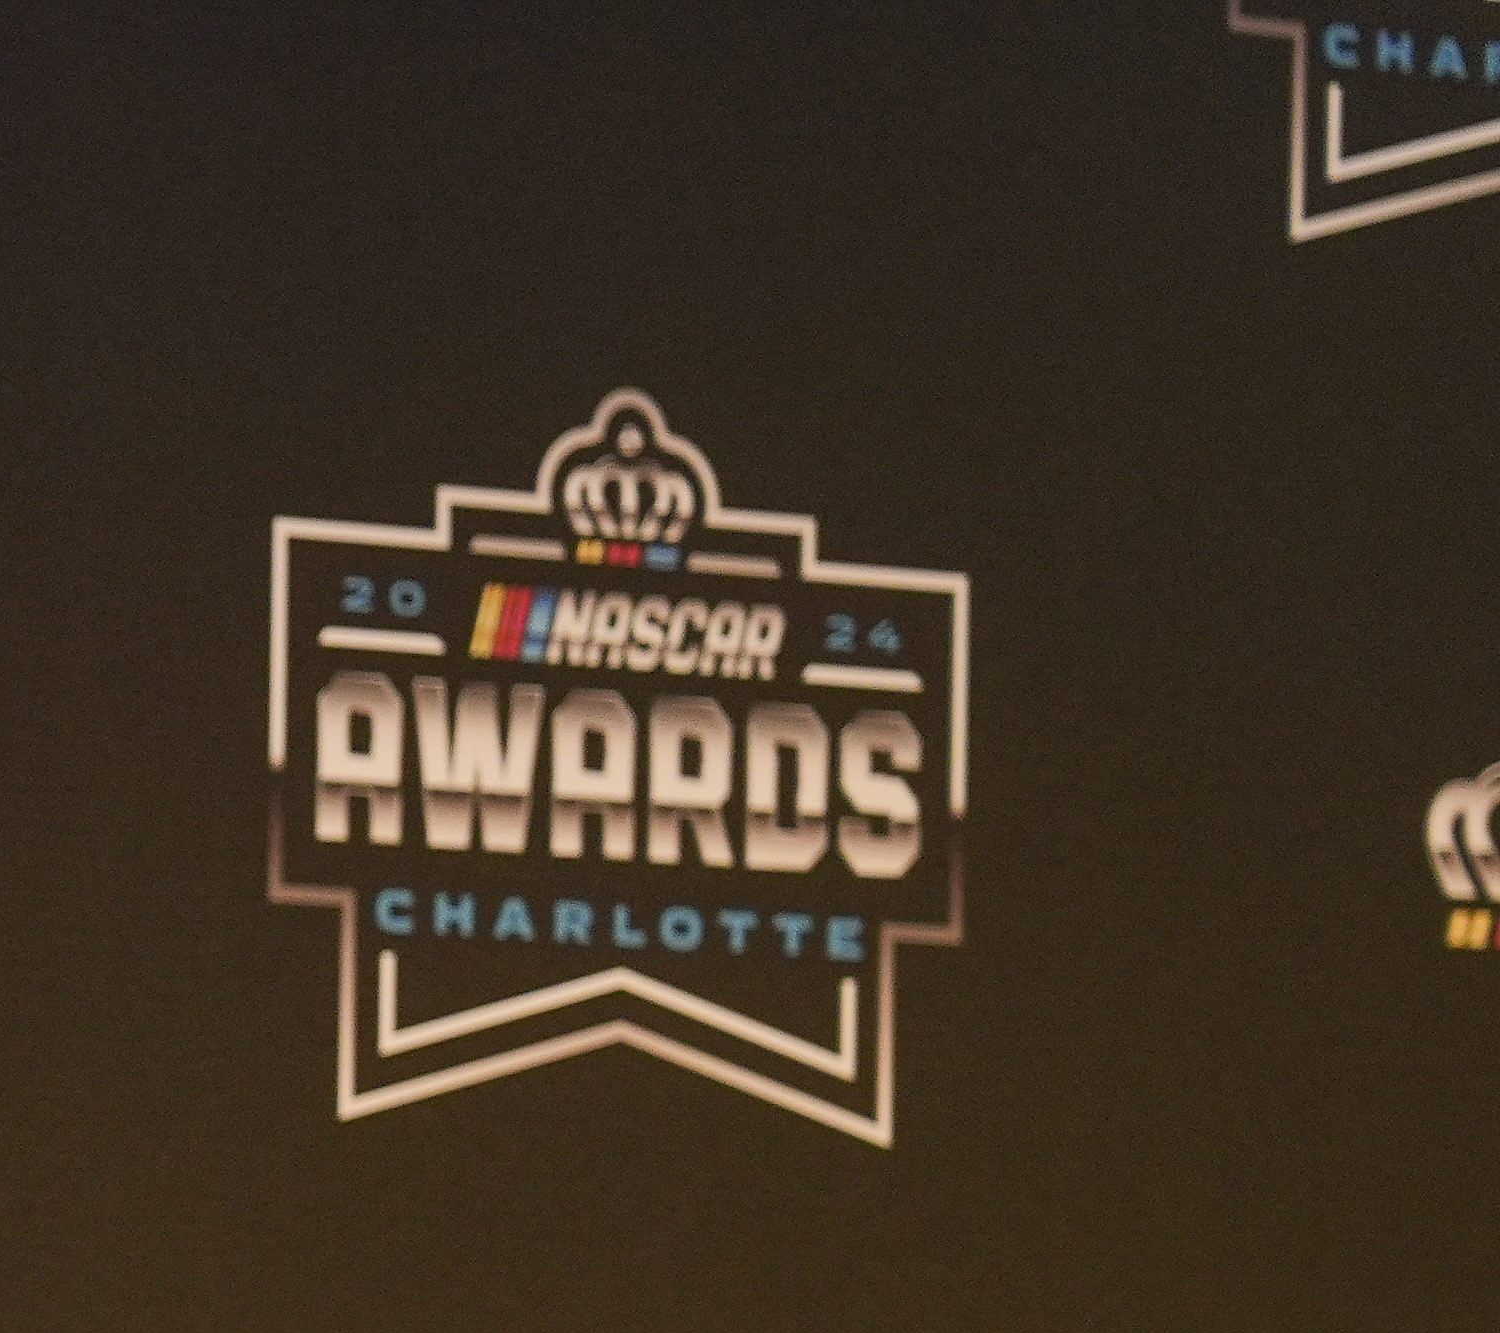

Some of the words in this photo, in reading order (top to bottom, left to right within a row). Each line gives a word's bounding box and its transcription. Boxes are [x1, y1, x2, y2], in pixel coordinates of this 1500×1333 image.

[342, 574, 429, 618] 20
[546, 587, 788, 682] NASCAR
[826, 612, 904, 654] 24
[314, 670, 923, 880] AWARDS
[372, 887, 866, 963] CHARLOTTE
